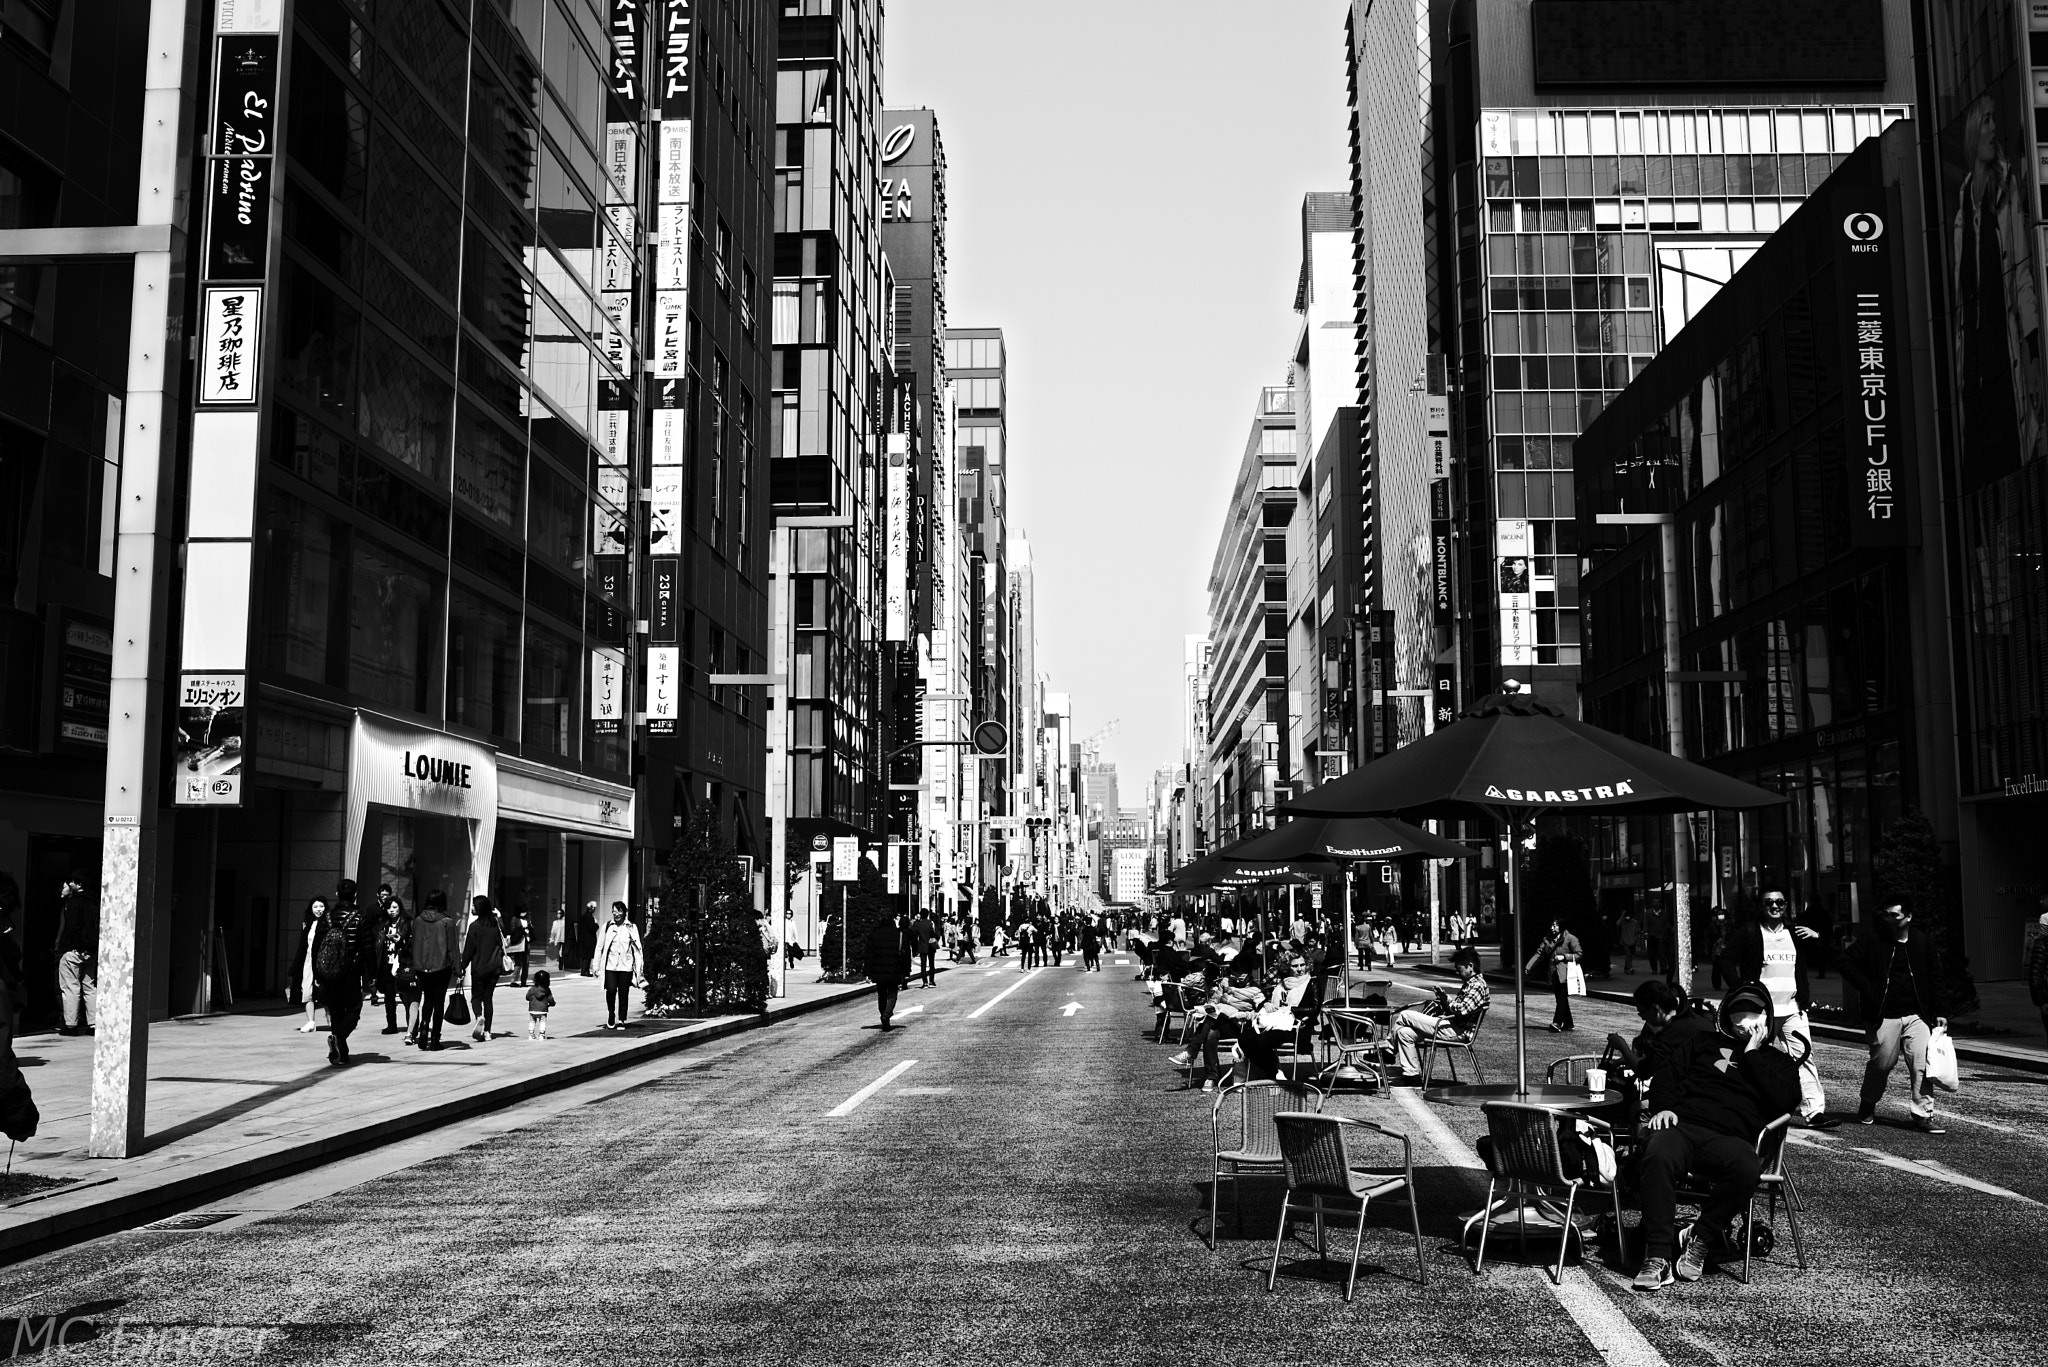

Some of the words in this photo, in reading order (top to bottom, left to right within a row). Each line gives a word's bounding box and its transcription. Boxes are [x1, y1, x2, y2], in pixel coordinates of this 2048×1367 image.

[243, 90, 268, 119] El
[237, 129, 265, 225] Padrino
[668, 138, 682, 197] 南日本放送
[1850, 243, 1878, 253] MUFG
[216, 295, 246, 396] 星乃珈琲店
[662, 313, 679, 371] テレビ宮崎
[1855, 292, 1895, 520] 三菱東京UFJ銀行
[664, 411, 673, 461] 三井住友銀行
[655, 484, 679, 493] レイア
[916, 496, 926, 561] DAMIANI
[1515, 521, 1525, 530] 5F
[1436, 535, 1448, 602] MONTBLANC
[65, 691, 73, 703] 2F
[184, 688, 241, 706] エリュシオン
[655, 653, 669, 715] 築地すし好
[915, 685, 928, 741] DAMIANI
[1328, 692, 1338, 718] ダンス
[404, 751, 472, 789] LOUNIE
[214, 782, 229, 792] B2
[1506, 781, 1633, 804] GAASTRA
[1120, 852, 1142, 860] LIXIL
[1325, 845, 1403, 856] ExcelHuman
